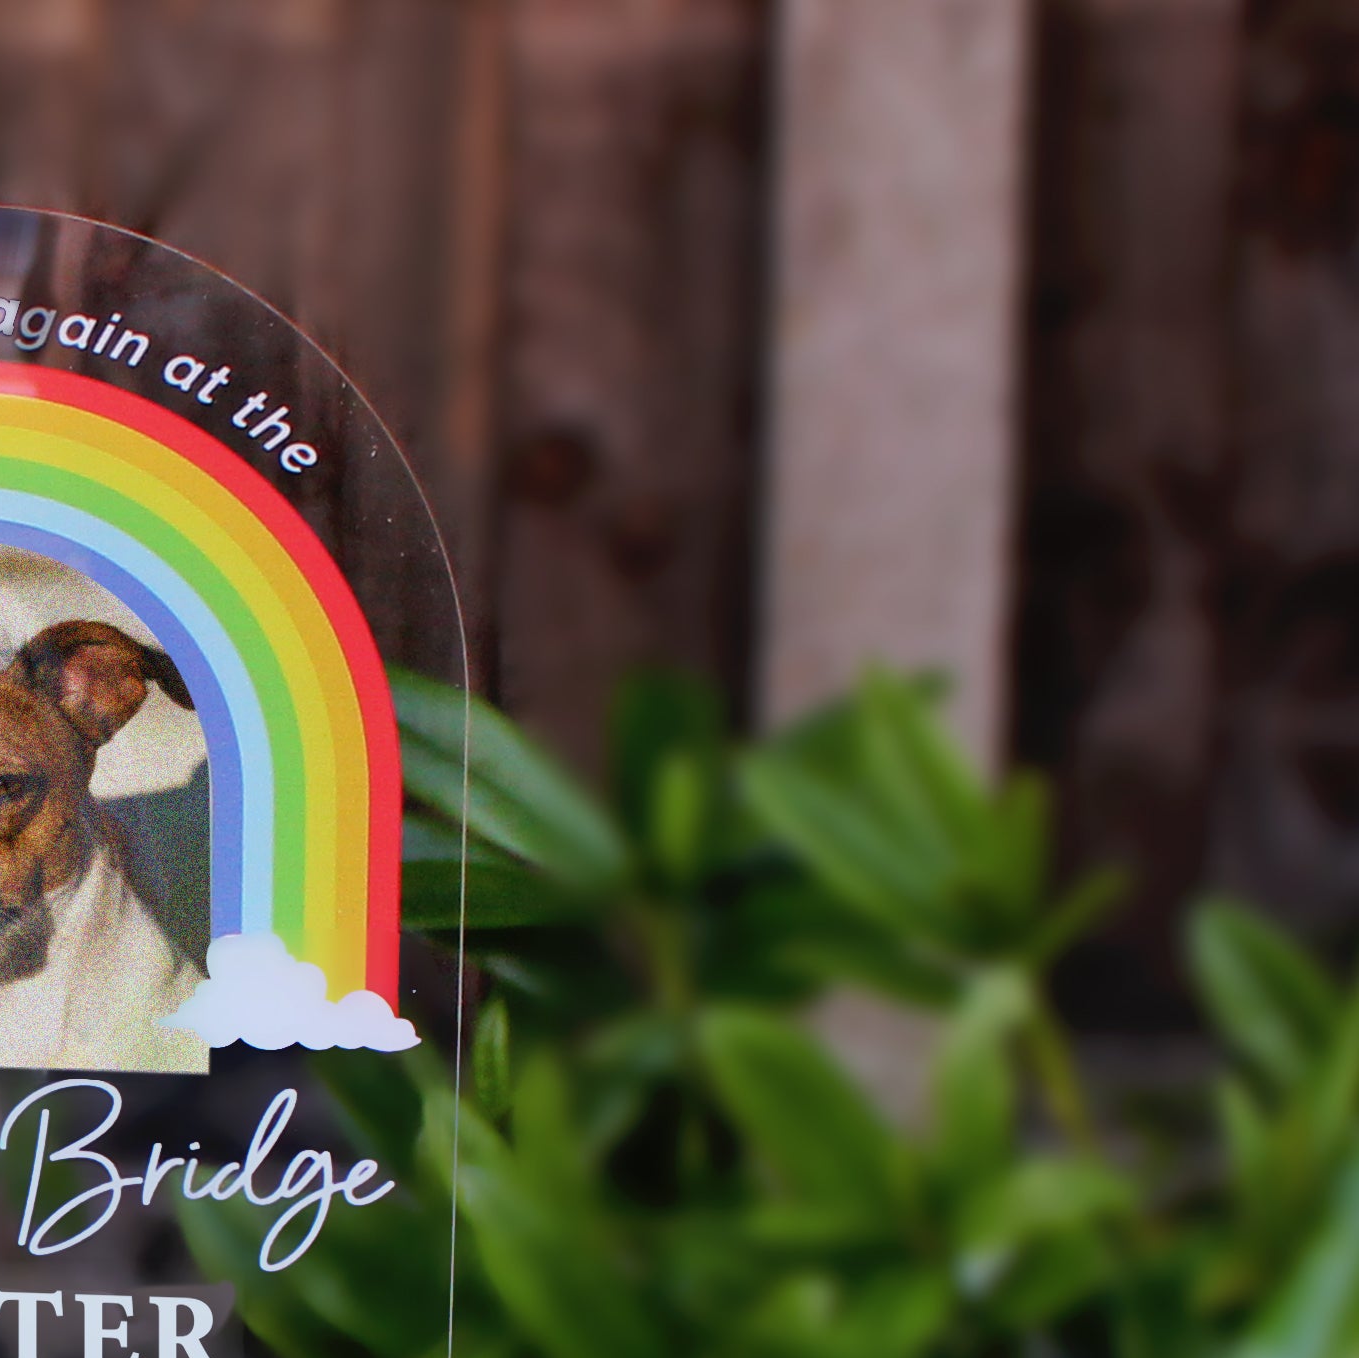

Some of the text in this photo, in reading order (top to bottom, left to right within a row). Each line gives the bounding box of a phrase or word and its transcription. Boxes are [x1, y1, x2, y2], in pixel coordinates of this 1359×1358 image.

[164, 353, 231, 404] at
[232, 392, 318, 474] the
[0, 1079, 396, 1273] Bridge
